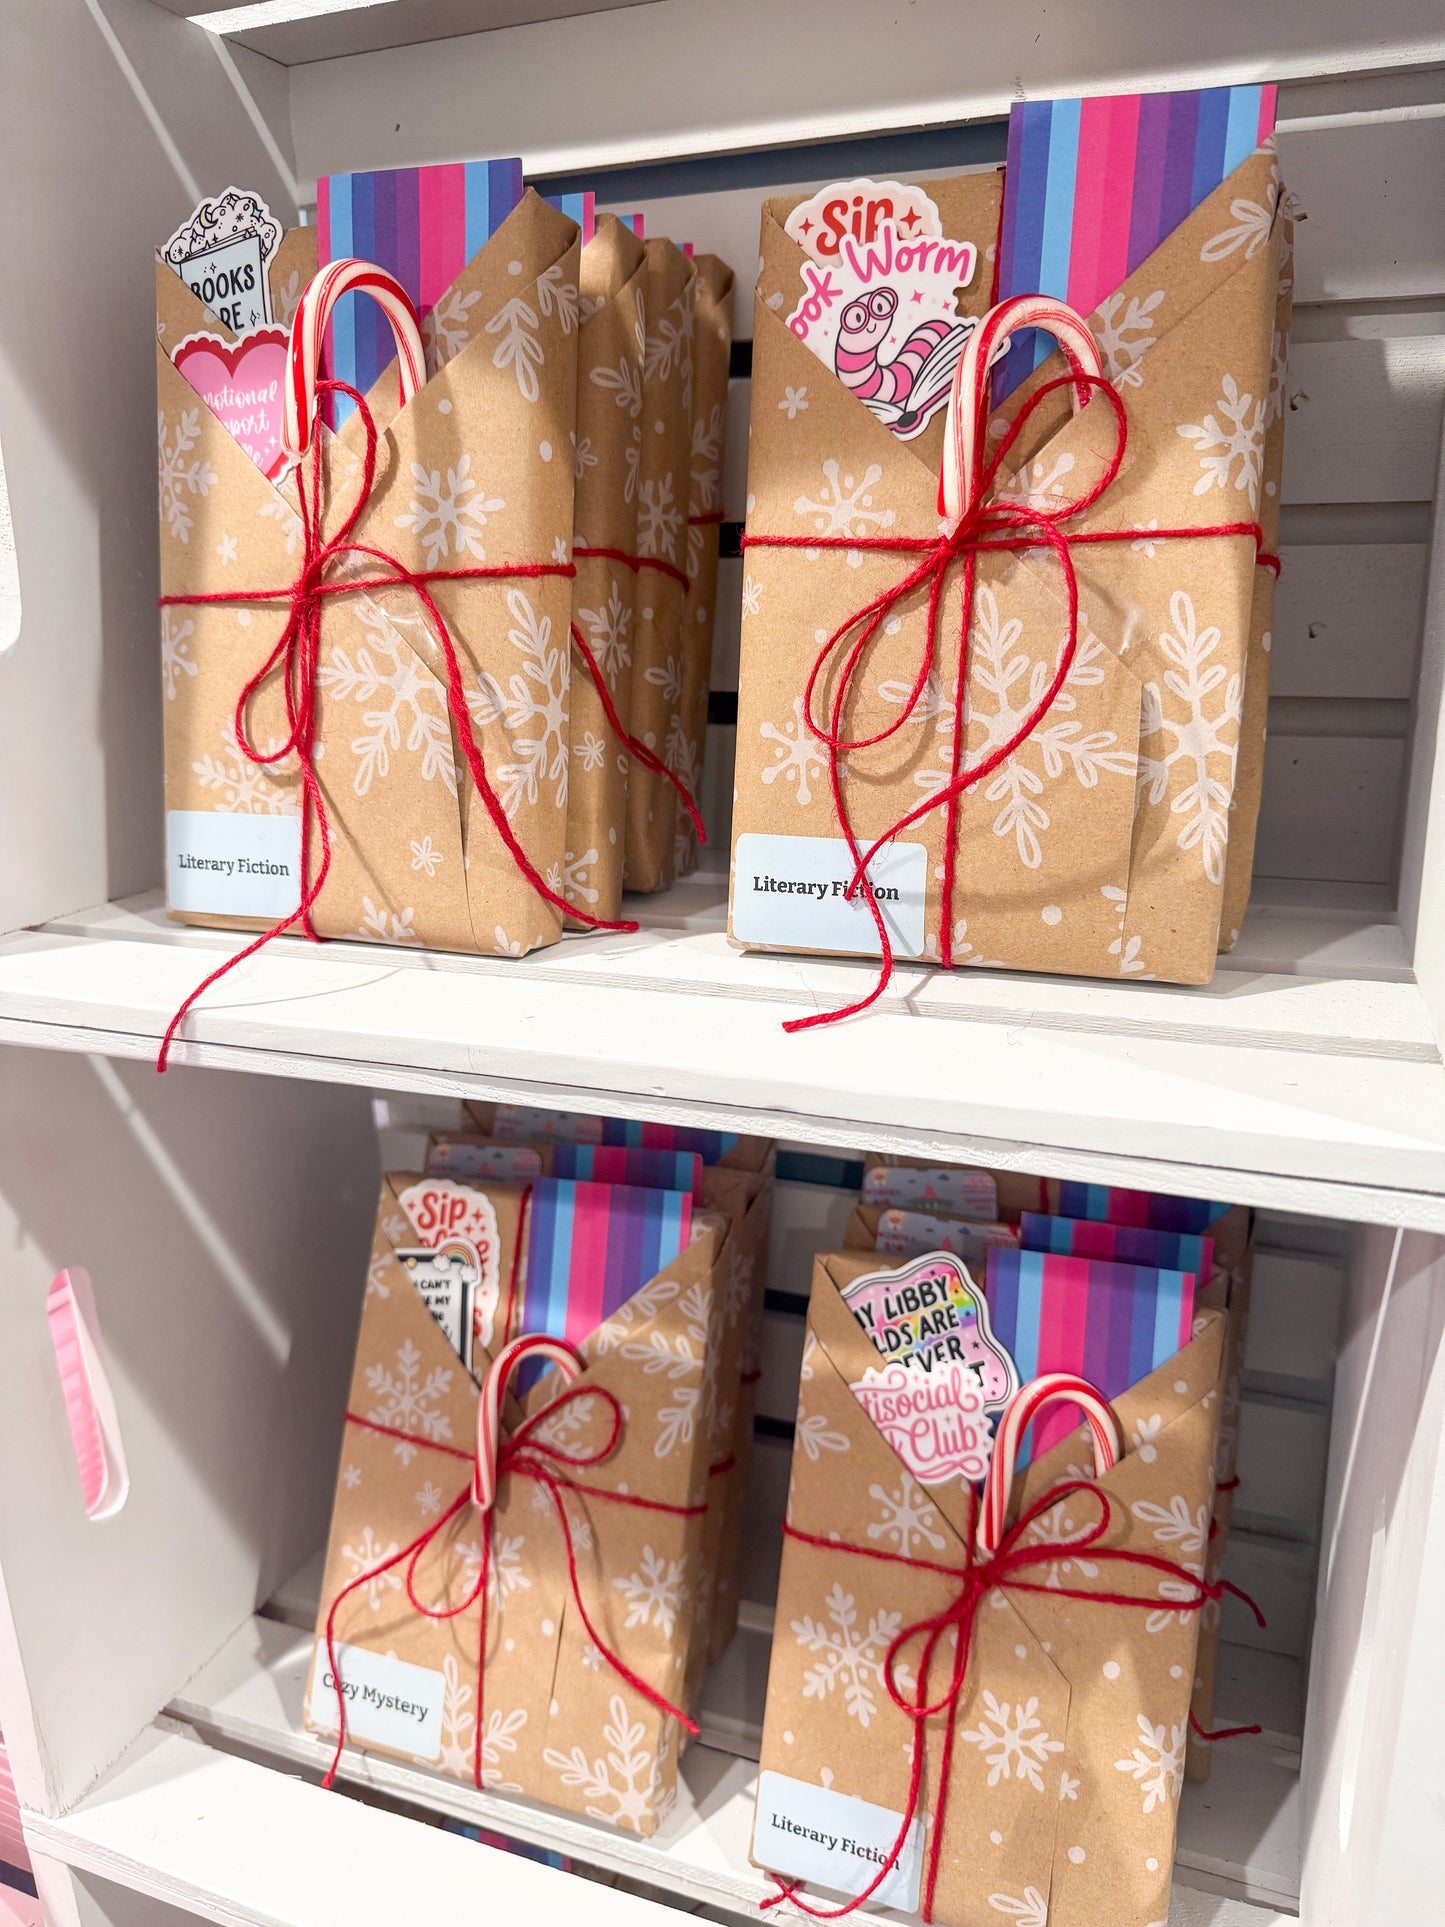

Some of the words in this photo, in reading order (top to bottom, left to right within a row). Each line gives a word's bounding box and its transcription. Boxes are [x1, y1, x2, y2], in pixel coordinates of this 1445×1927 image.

[790, 267, 843, 341] ook
[845, 226, 970, 283] Worm
[219, 302, 245, 331] RE
[178, 854, 235, 876] Literary
[237, 858, 290, 876] Fiction
[753, 875, 828, 900] Literary
[417, 1191, 467, 1230] Sip
[884, 1275, 948, 1320] LIBBY
[920, 1304, 960, 1341] ARE
[908, 1413, 977, 1462] Club
[323, 1672, 359, 1700] Czy
[362, 1684, 429, 1722] Mystery
[771, 1812, 838, 1850] Literary
